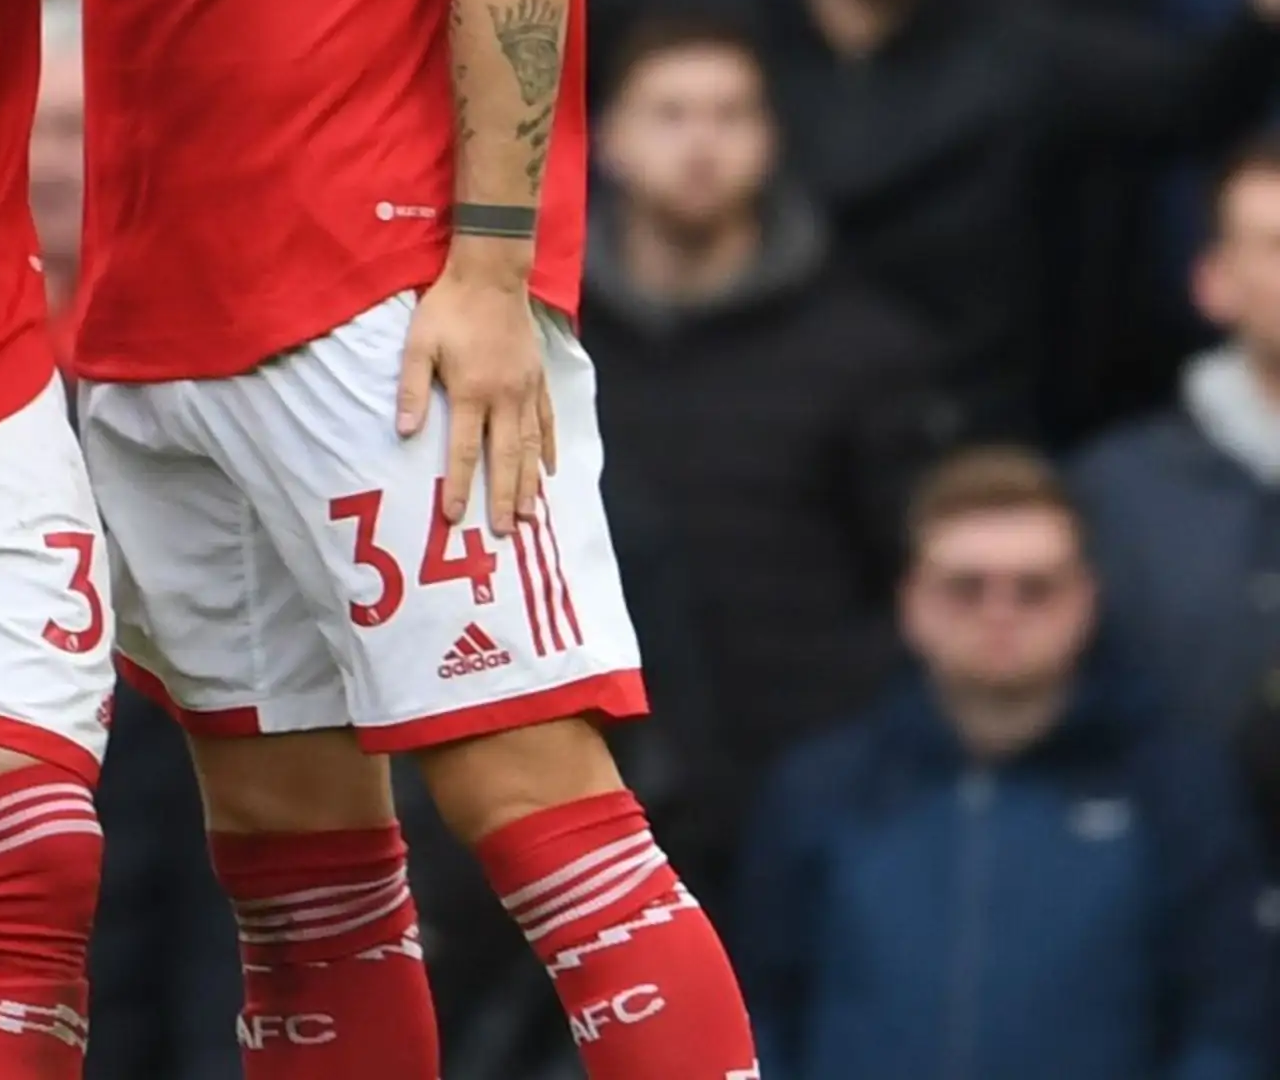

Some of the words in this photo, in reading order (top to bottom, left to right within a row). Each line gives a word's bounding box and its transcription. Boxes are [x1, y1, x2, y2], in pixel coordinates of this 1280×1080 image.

[329, 477, 497, 629] 34
[41, 531, 104, 654] 3
[437, 649, 511, 681] adidas
[236, 1013, 338, 1049] AFC
[570, 984, 667, 1047] AFC
